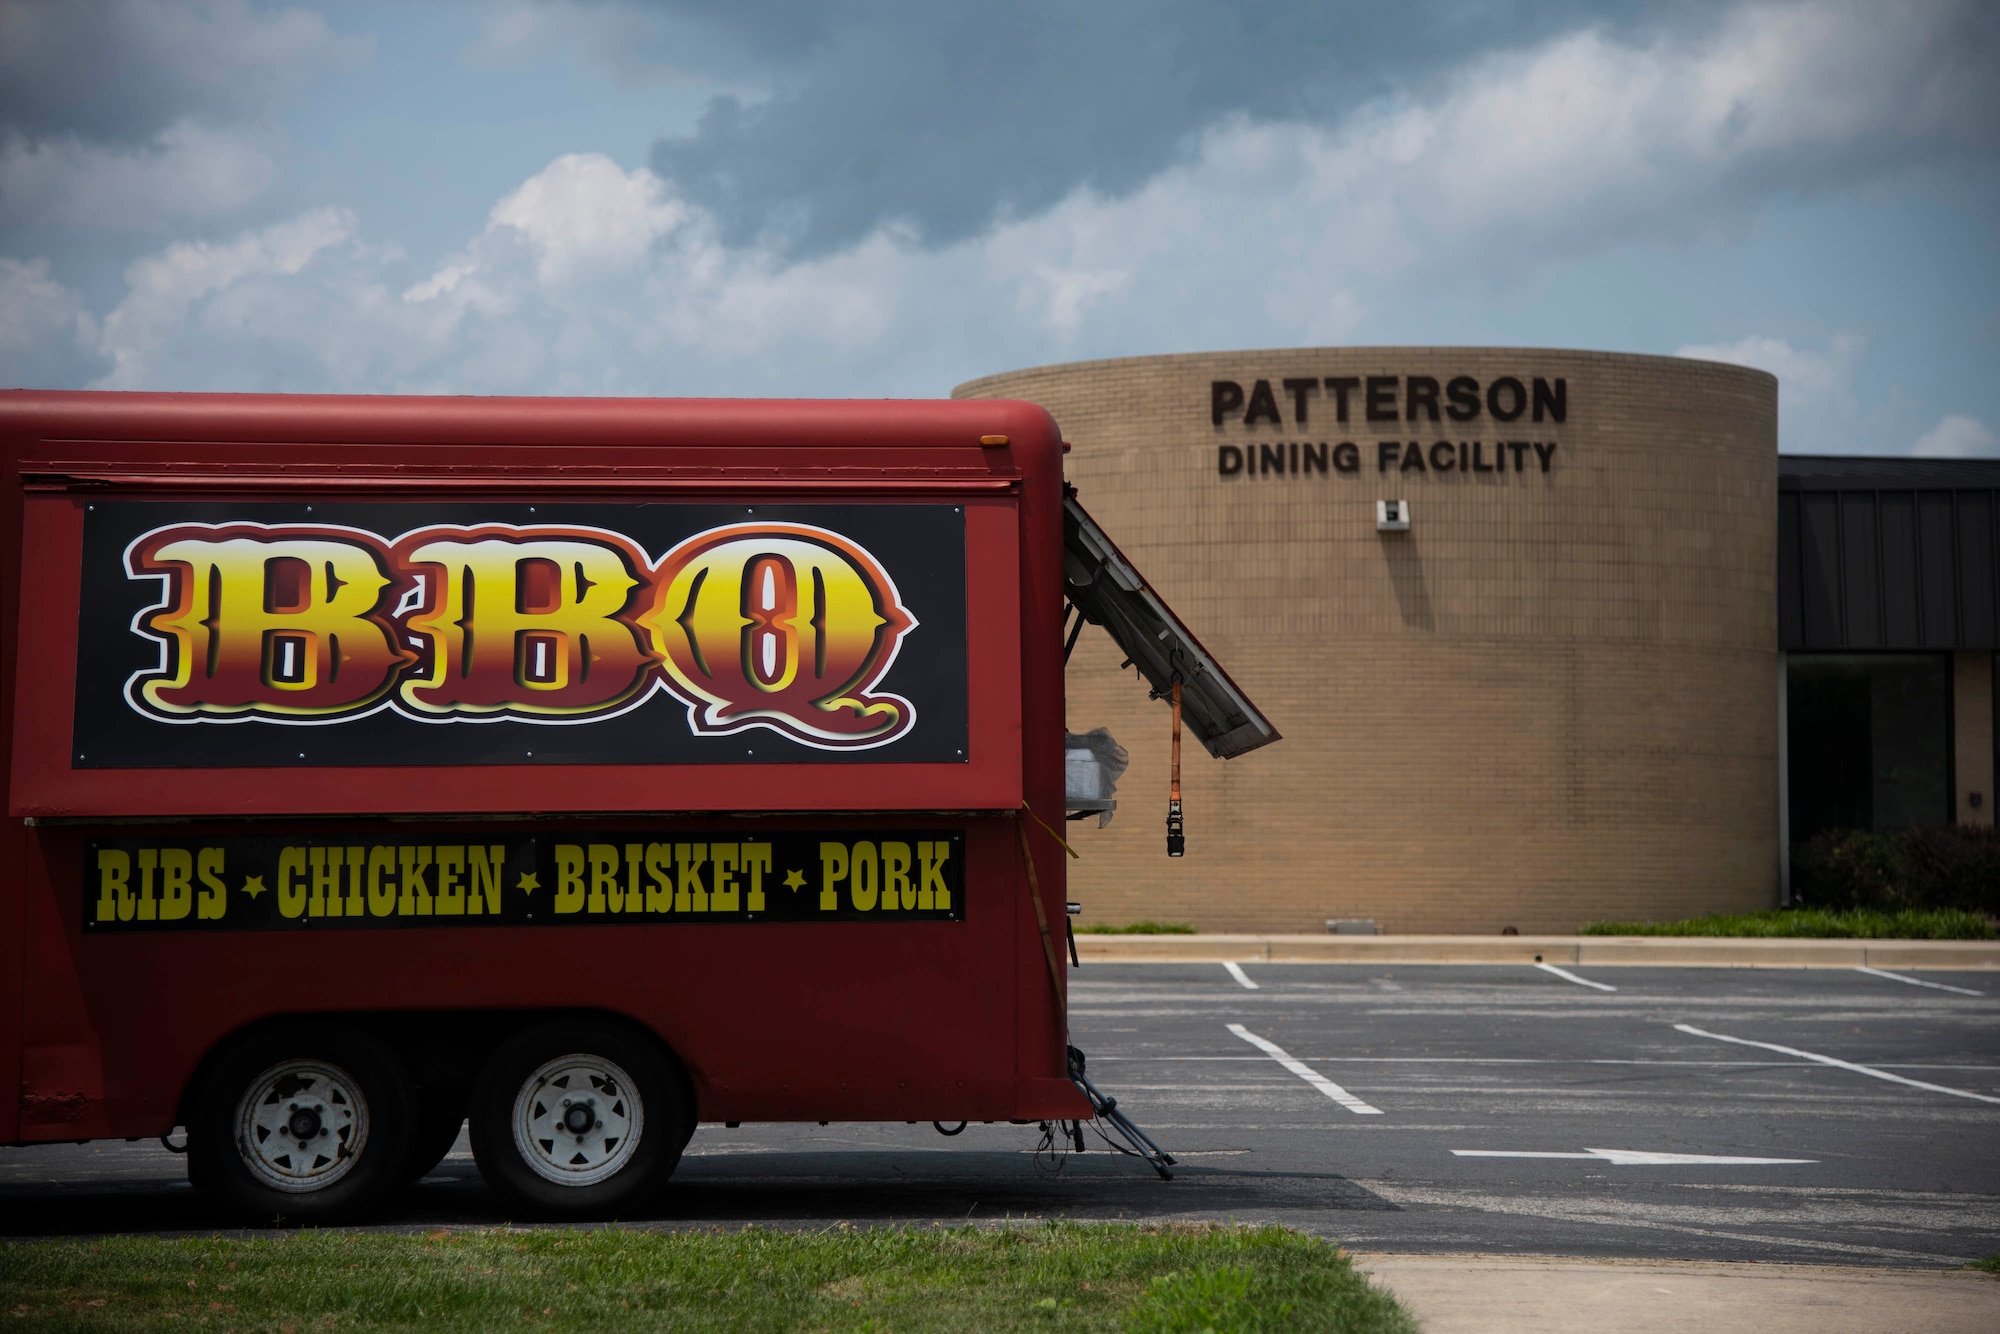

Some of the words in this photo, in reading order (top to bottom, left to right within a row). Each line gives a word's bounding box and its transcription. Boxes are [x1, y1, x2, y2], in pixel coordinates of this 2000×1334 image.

[1211, 375, 1567, 425] PATTERSON
[1218, 443, 1360, 475] DINING
[1378, 442, 1556, 473] FACILITY
[123, 521, 919, 751] BBQ
[97, 847, 227, 922] RIBS
[277, 845, 505, 919] CHICKEN
[554, 842, 772, 914] BRISKET
[819, 840, 951, 912] PORK
